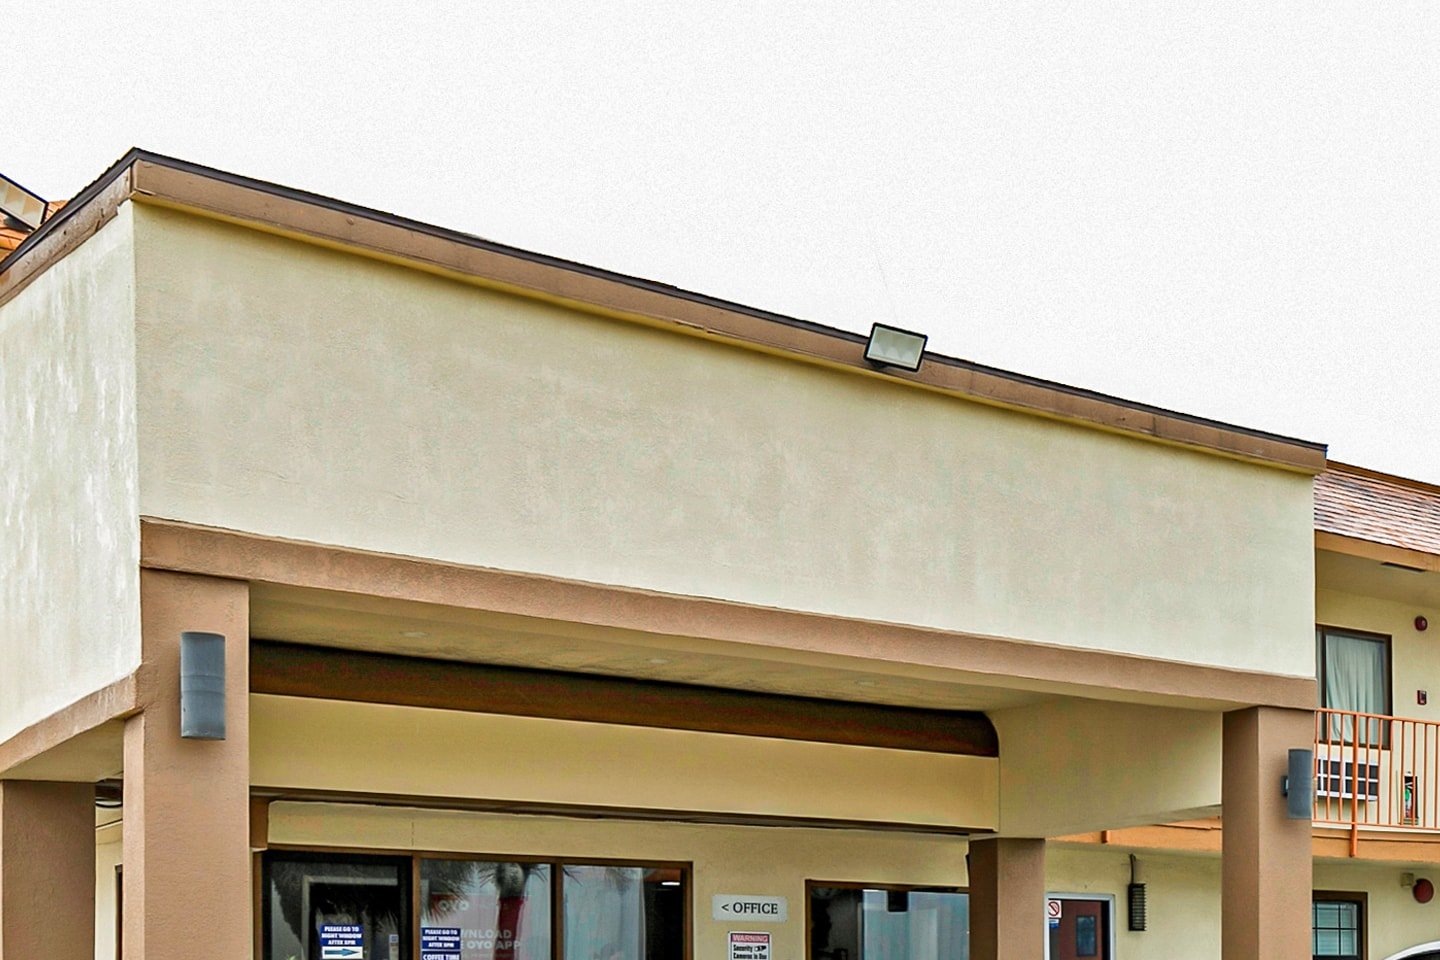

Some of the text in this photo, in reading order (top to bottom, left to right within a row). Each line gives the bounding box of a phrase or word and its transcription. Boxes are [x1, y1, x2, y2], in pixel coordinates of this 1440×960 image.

[733, 902, 778, 914] OFFICE
[732, 934, 768, 942] WARNING
[466, 940, 493, 950] OYO
[495, 941, 521, 950] APP
[733, 944, 753, 953] Security
[733, 952, 753, 960] Cameras
